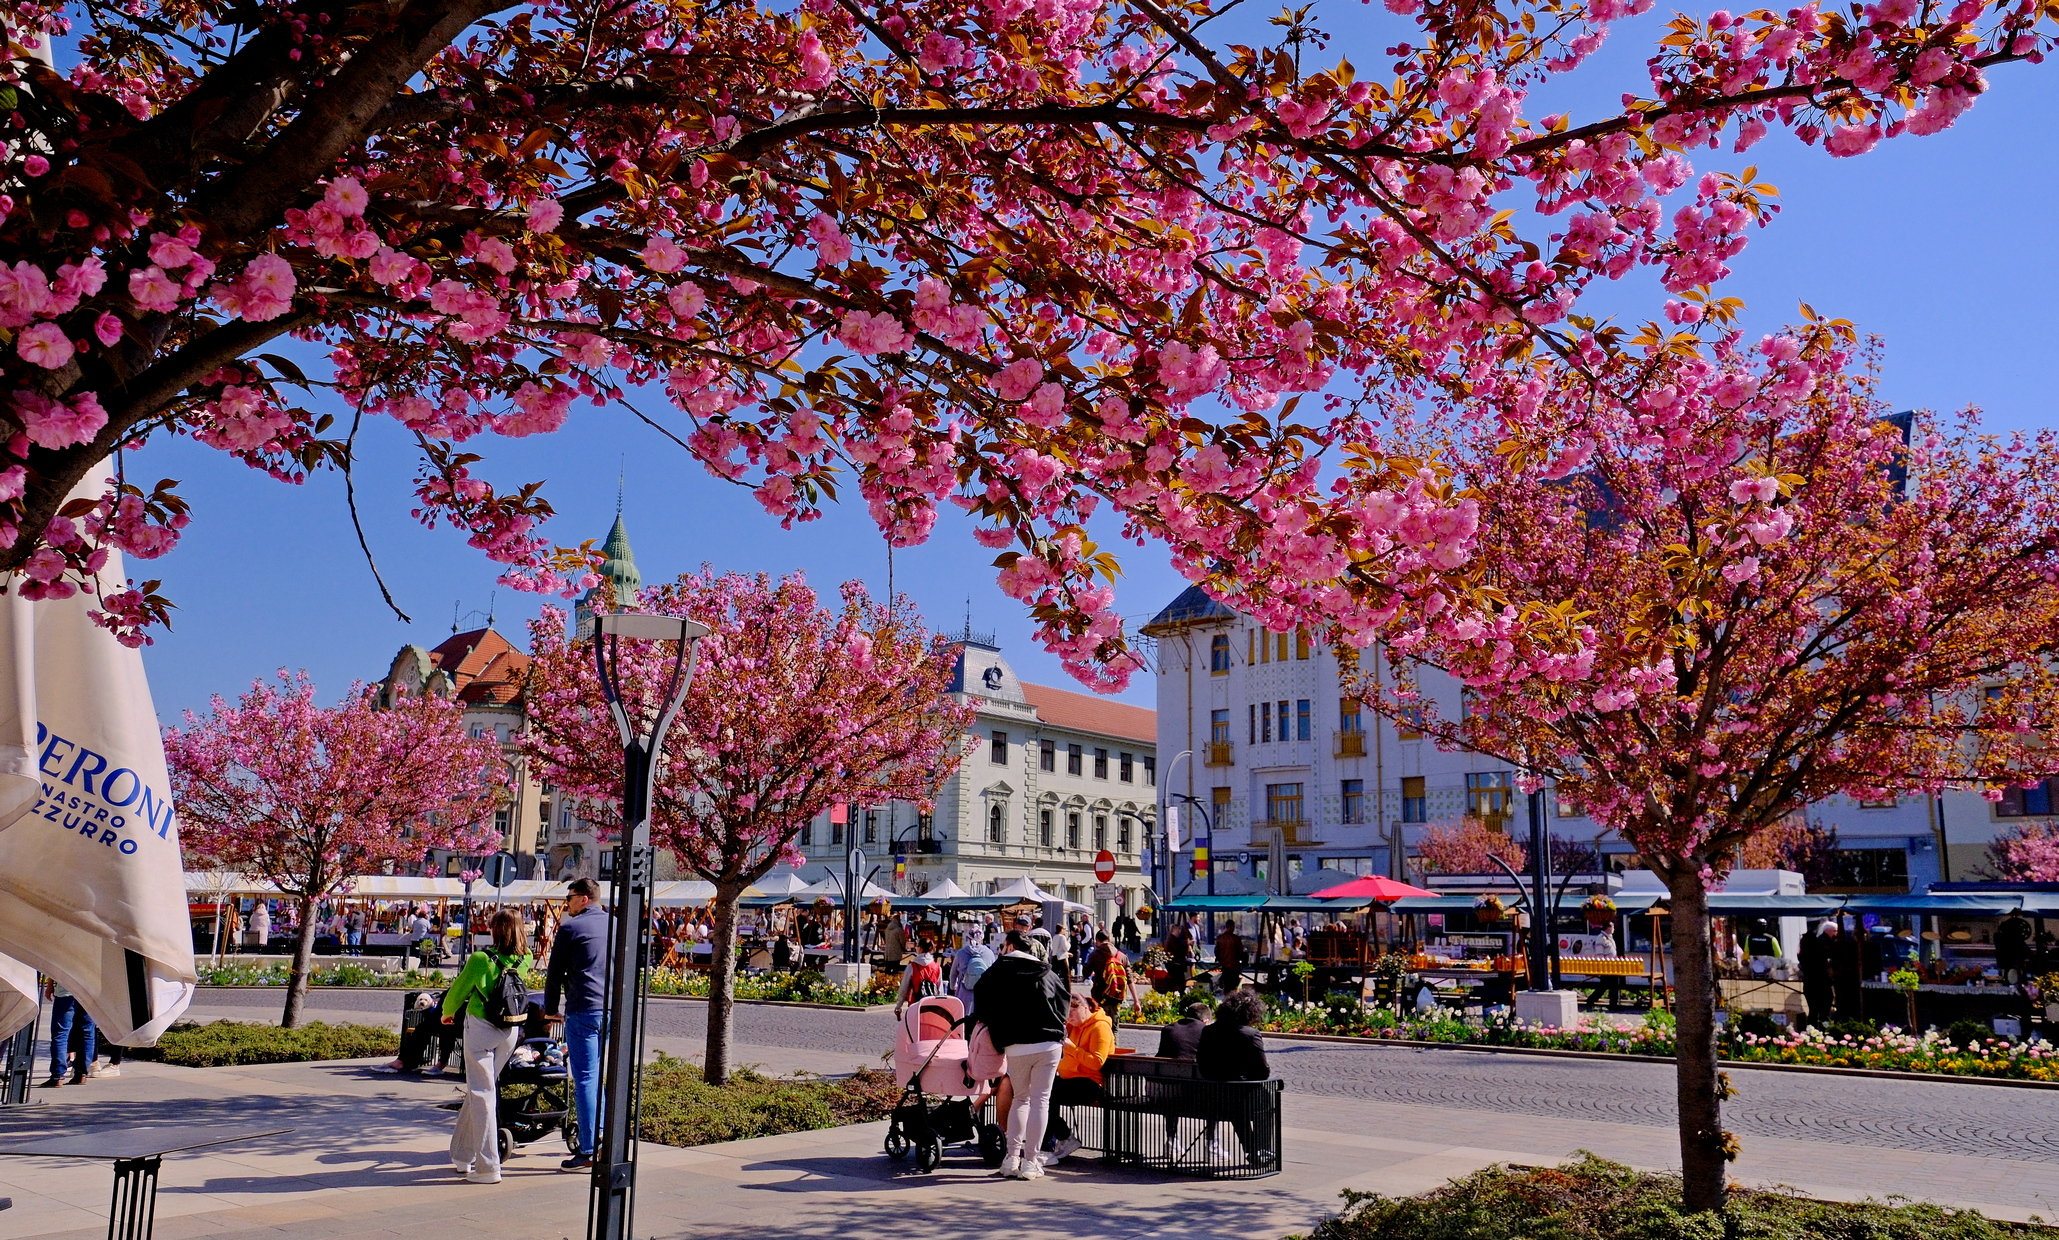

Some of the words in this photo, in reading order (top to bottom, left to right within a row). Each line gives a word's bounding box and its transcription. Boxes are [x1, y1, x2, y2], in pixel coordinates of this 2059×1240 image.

[30, 799, 138, 855] ZZURRO
[41, 782, 126, 829] NASTRO
[1448, 934, 1504, 947] Tiramisu
